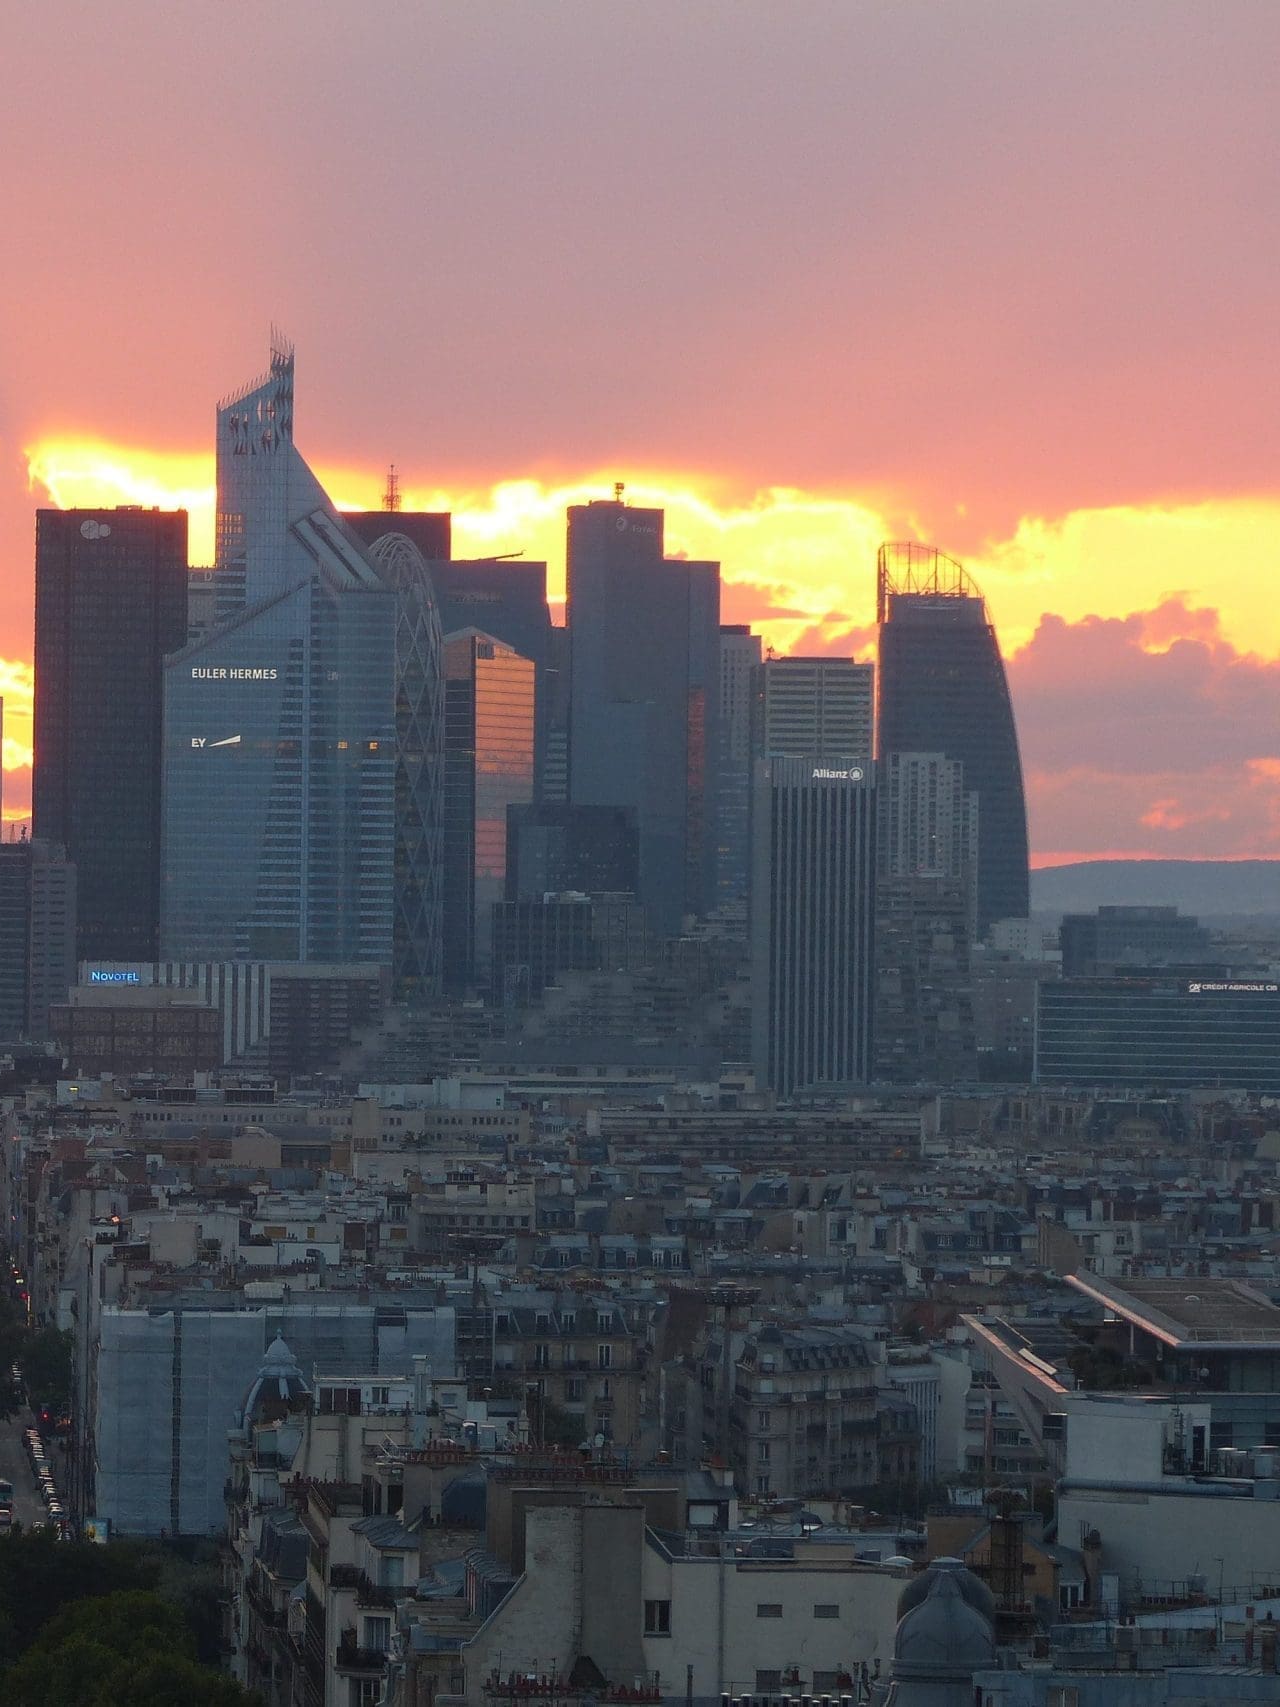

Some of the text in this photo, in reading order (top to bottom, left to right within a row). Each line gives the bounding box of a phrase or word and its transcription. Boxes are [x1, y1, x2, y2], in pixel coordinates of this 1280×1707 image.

[191, 668, 278, 679] EULER HERMES
[191, 737, 207, 748] EY
[812, 769, 849, 779] Allianz
